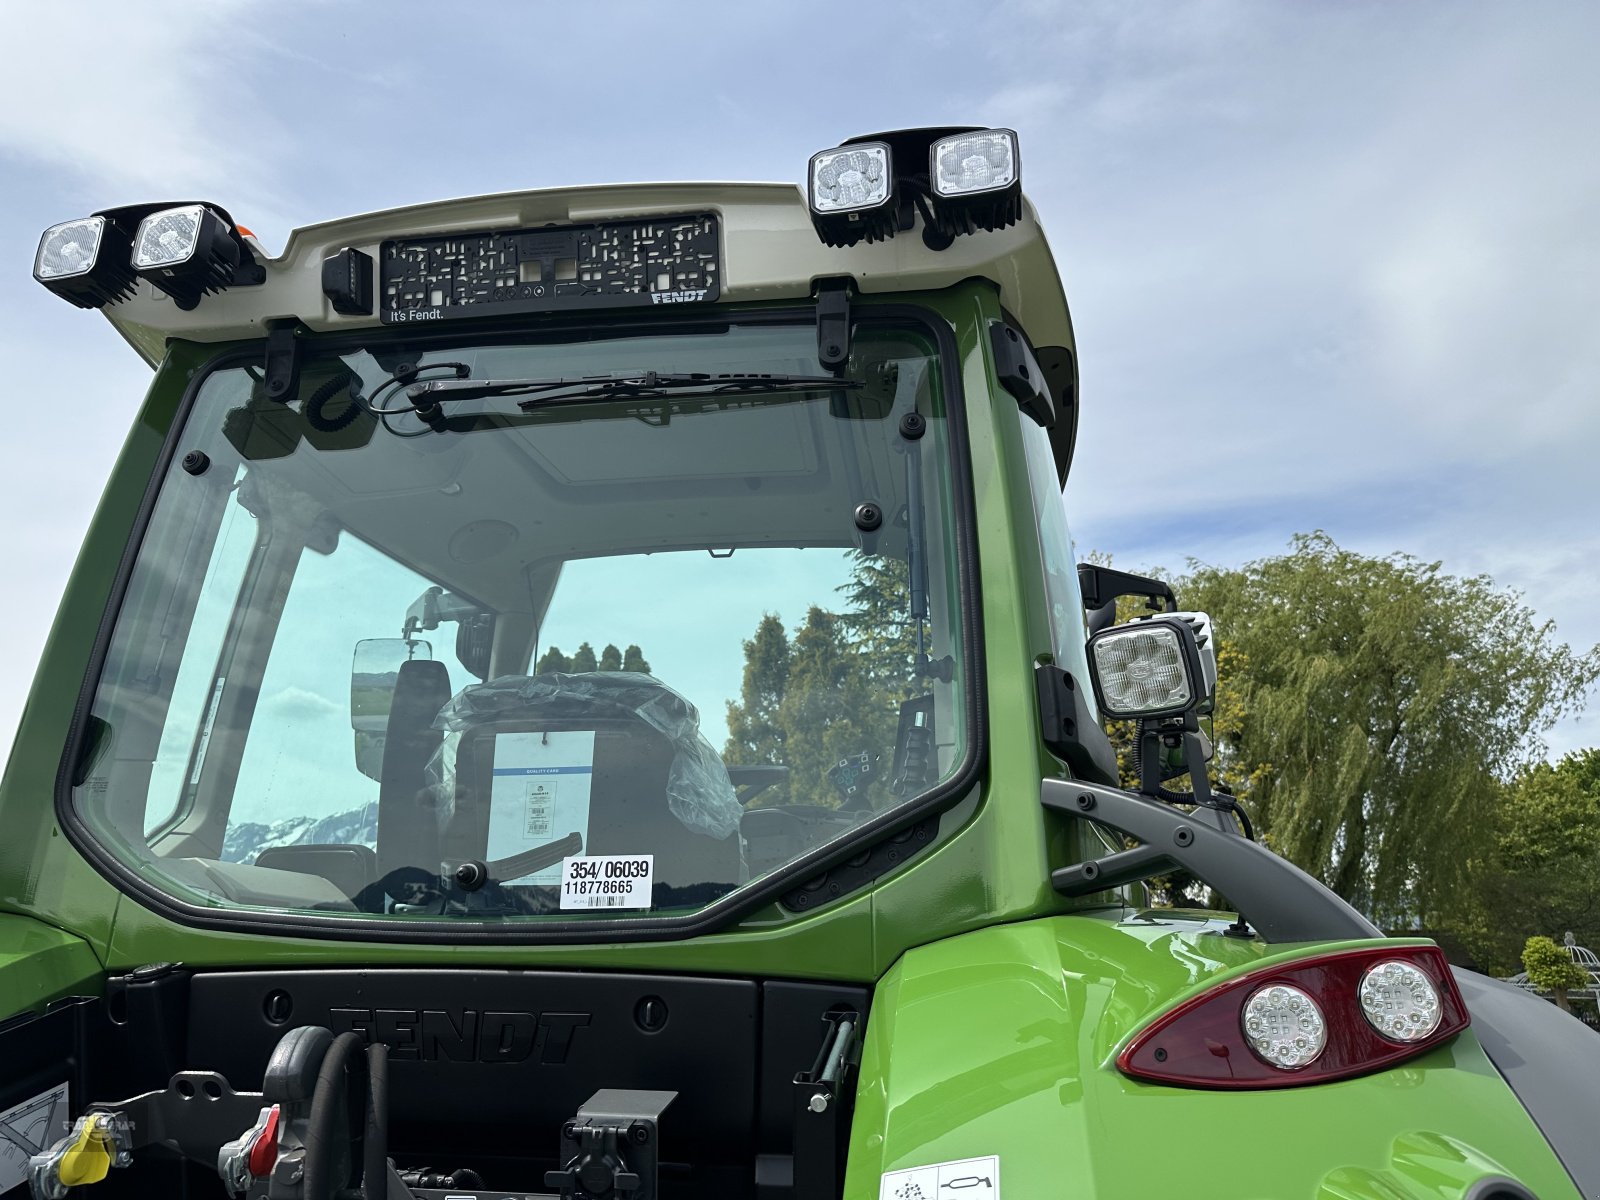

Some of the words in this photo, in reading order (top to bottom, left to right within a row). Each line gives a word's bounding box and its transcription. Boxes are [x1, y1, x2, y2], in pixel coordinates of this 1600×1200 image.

[651, 289, 708, 304] FENDT
[391, 310, 406, 321] It's
[409, 308, 444, 321] Fendt.
[565, 880, 633, 895] 118778665
[330, 1008, 592, 1065] FENDT
